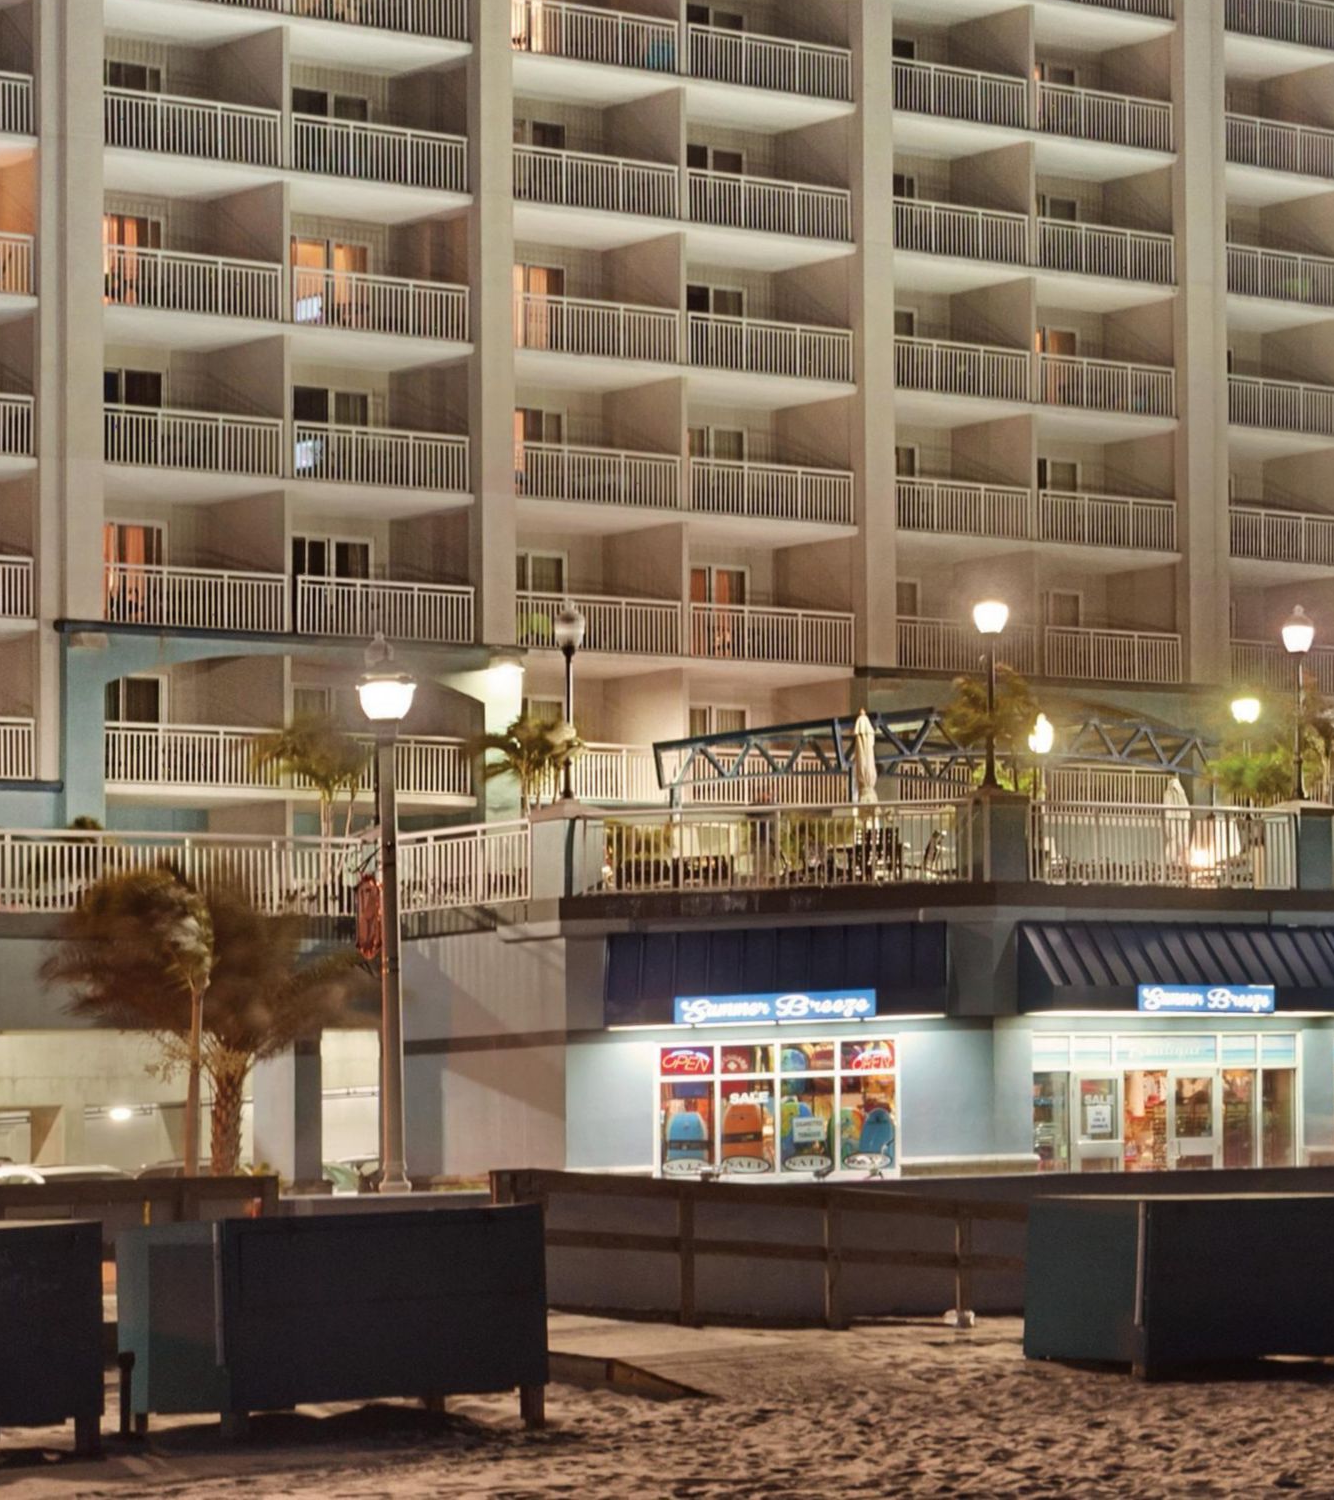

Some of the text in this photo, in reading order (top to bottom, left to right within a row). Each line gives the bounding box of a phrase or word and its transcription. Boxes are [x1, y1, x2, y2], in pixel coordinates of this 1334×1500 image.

[680, 994, 871, 1022] Summer Breeze
[1142, 987, 1271, 1013] Summer Breeze
[662, 1053, 710, 1073] OPEN
[729, 1091, 772, 1104] SALE
[1084, 1094, 1114, 1105] SALE
